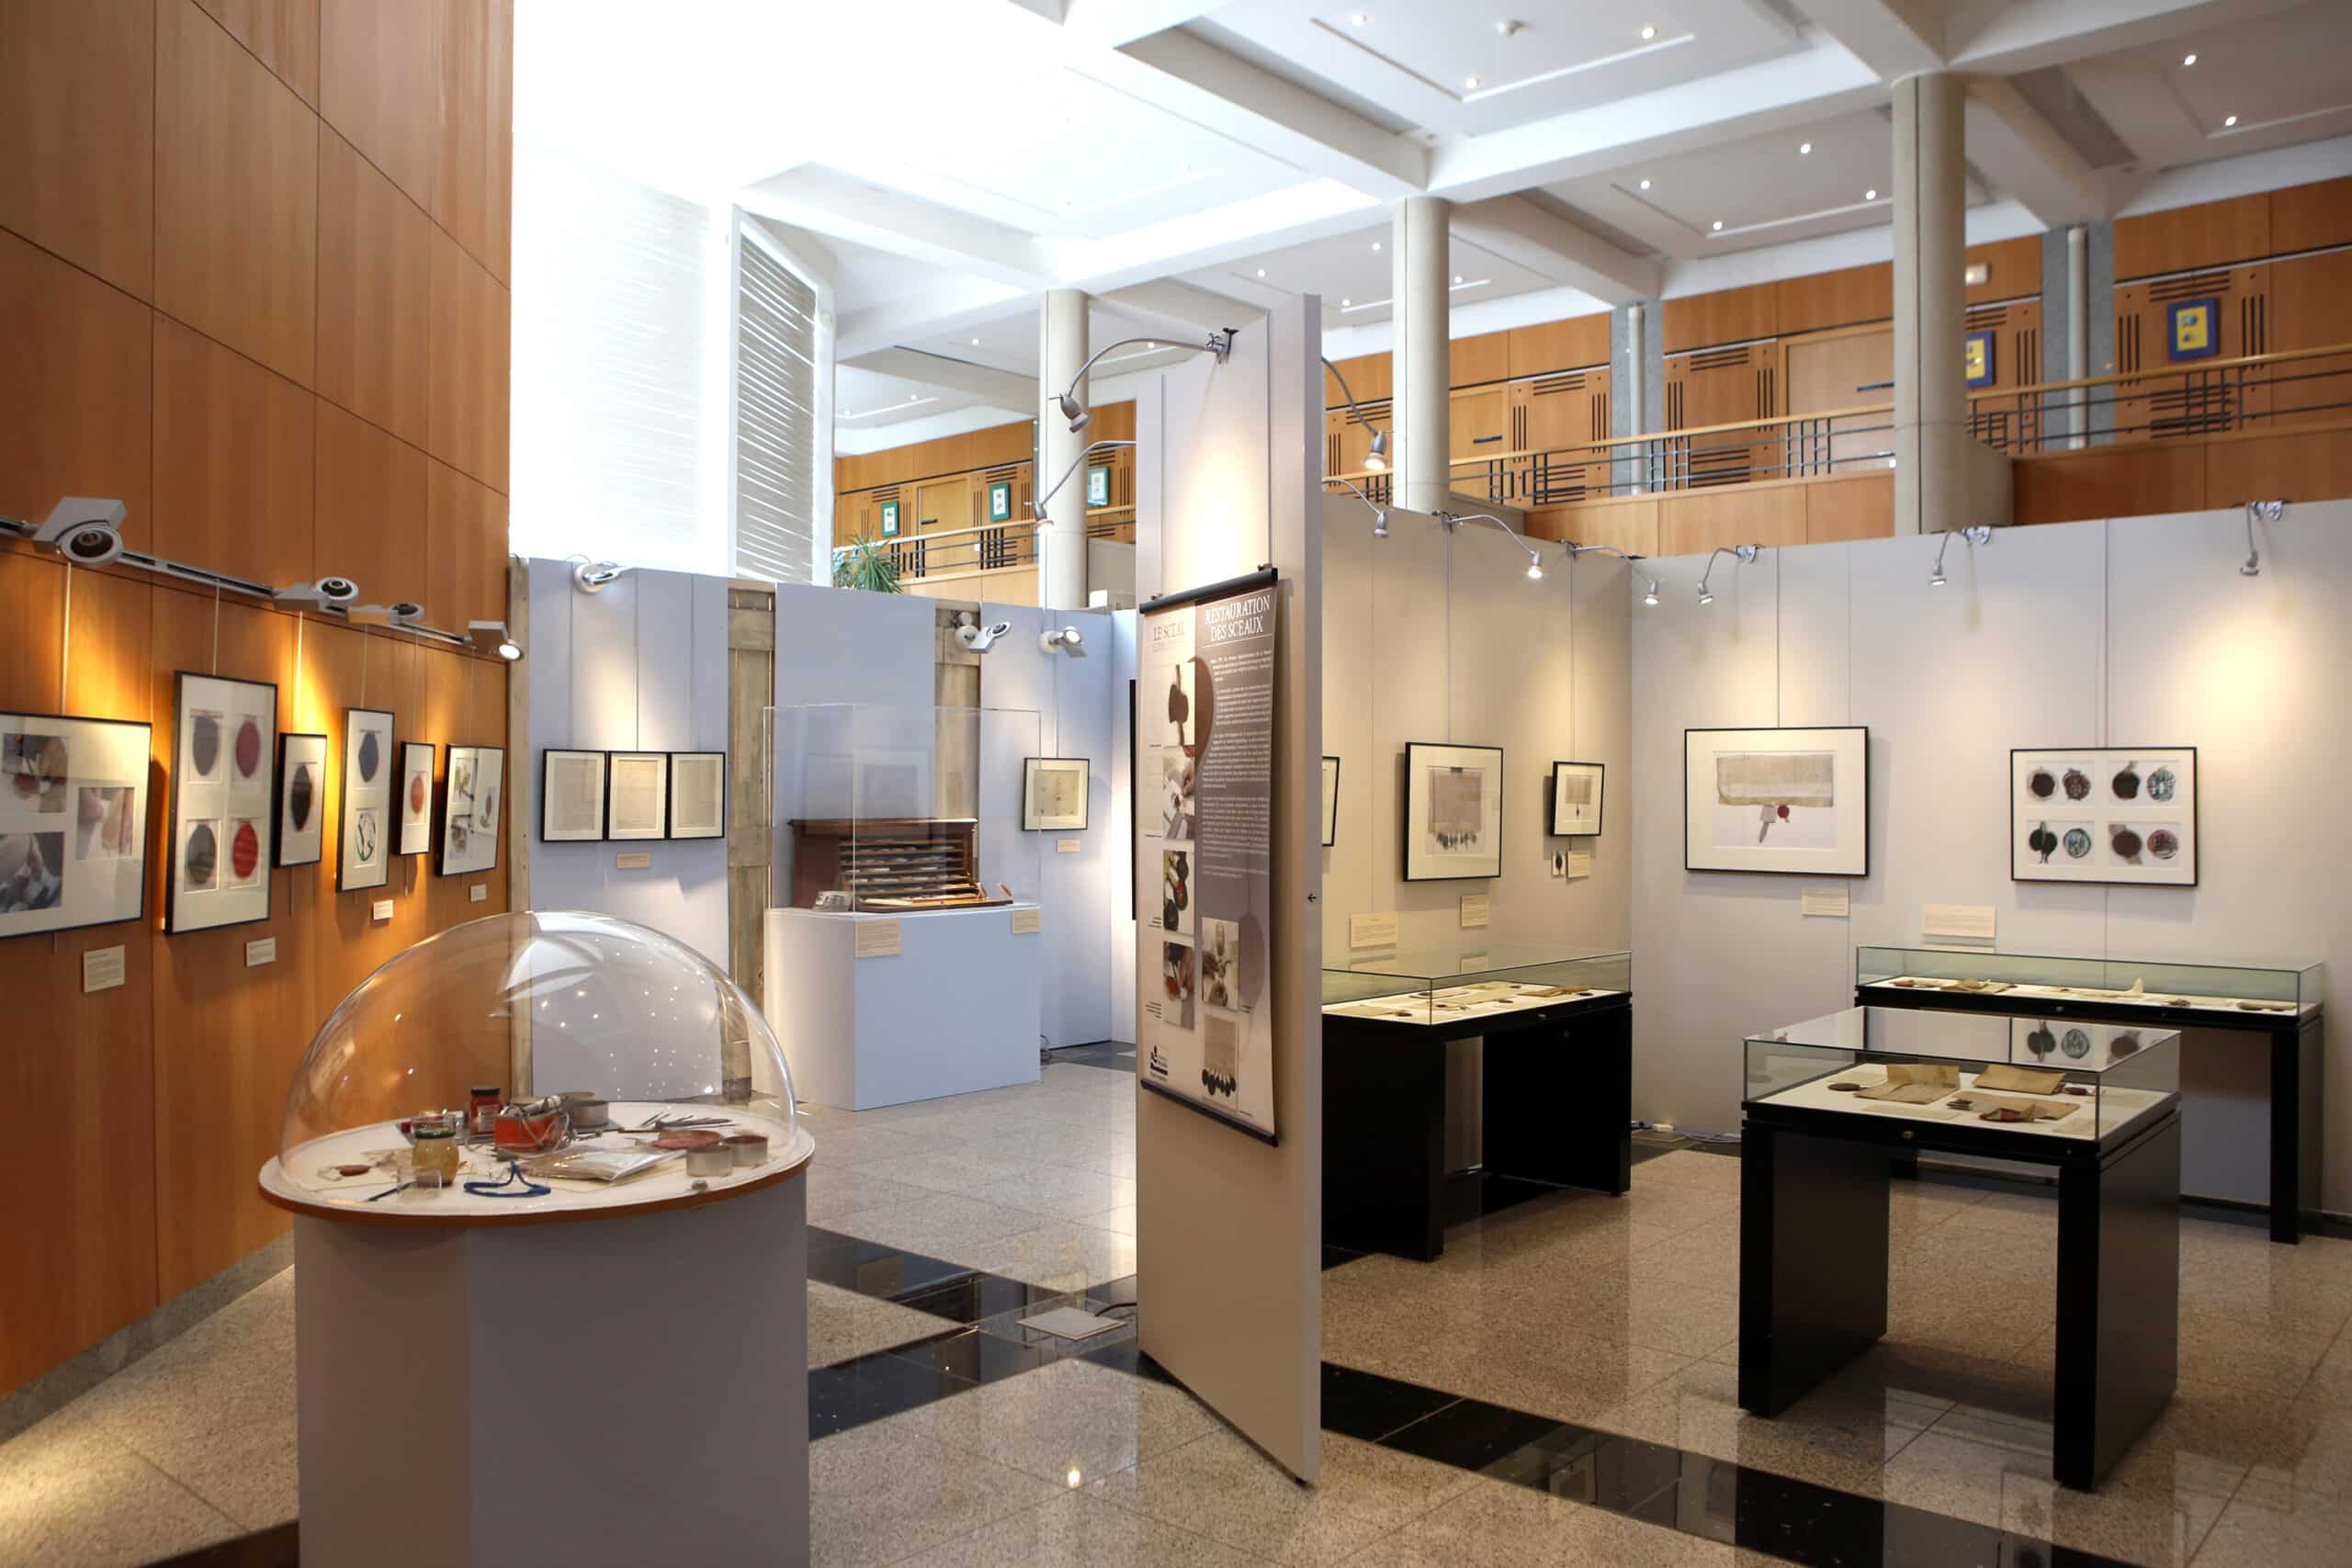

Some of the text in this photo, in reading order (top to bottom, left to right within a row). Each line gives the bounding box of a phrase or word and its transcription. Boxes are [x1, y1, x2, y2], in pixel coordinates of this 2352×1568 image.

[1205, 595, 1271, 625] RESTAURATION
[1211, 616, 1264, 642] DES SCEAUX
